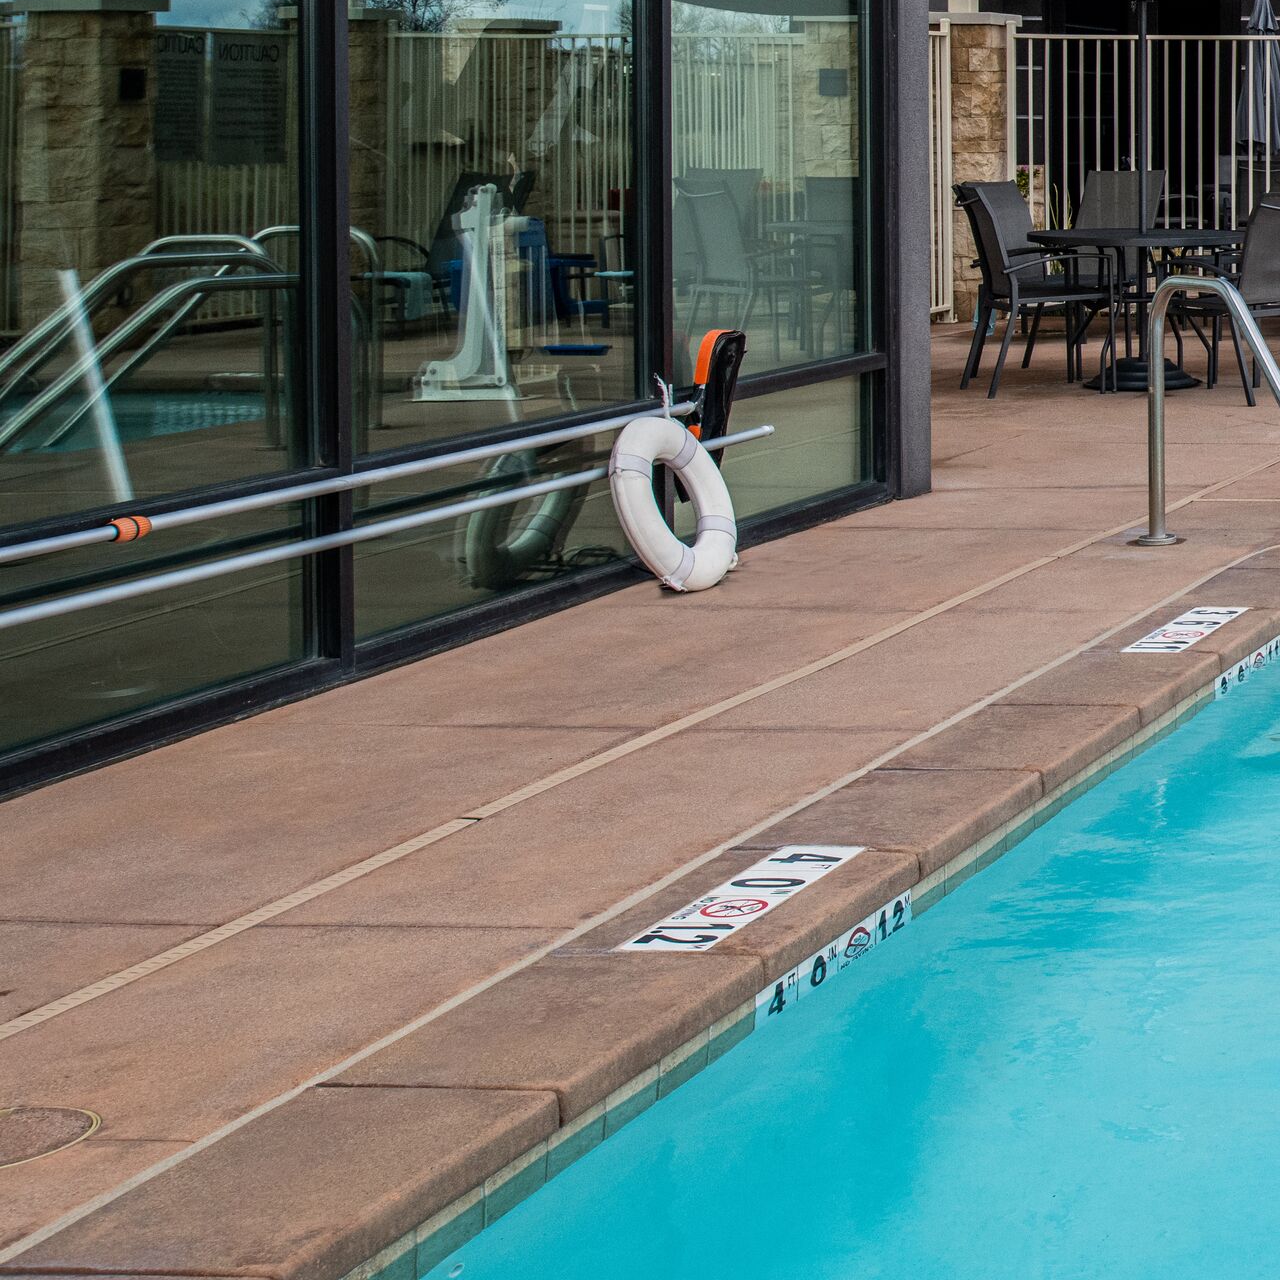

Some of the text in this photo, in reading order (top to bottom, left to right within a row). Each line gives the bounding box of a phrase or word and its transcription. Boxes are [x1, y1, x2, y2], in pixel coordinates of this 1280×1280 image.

[768, 853, 842, 864] 4
[730, 878, 806, 888] 0
[768, 981, 786, 1016] 4
[788, 972, 796, 989] FT
[827, 944, 838, 962] IN
[878, 900, 904, 941] 1.2
